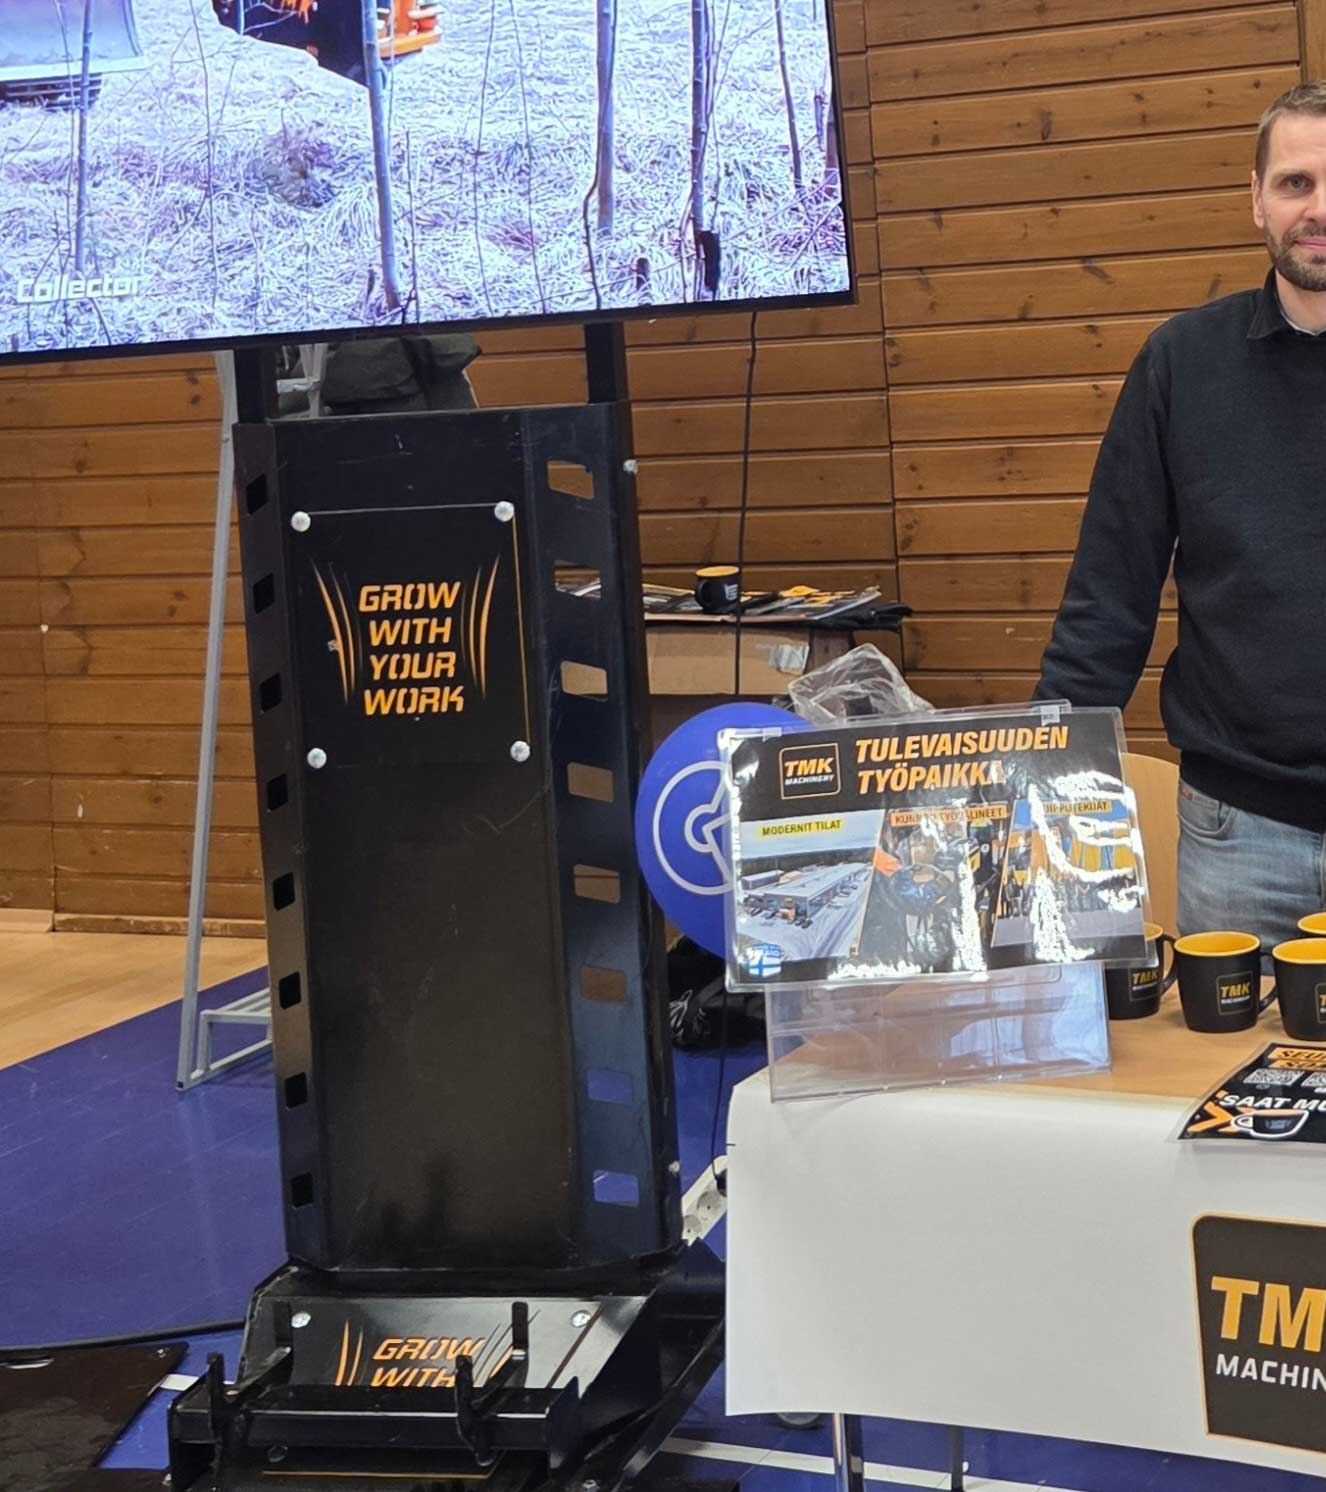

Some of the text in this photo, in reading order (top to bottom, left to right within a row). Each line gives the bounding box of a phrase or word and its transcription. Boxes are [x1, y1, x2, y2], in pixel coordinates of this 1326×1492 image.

[18, 273, 149, 303] Collector
[359, 582, 461, 612] GROW
[369, 617, 452, 646] WITH
[369, 651, 456, 681] YOUR
[363, 685, 464, 716] WORK
[855, 726, 1069, 764] TULEVAISUUDEN
[784, 757, 834, 777] TMK
[785, 774, 834, 786] MACHINERY
[858, 760, 1007, 794] TYÖPAIKKA
[762, 819, 842, 836] MODERNIT TILAT
[1220, 982, 1251, 998] TMK
[1220, 1095, 1291, 1109] SAAT
[373, 1338, 486, 1361] GROW
[370, 1367, 458, 1387] WITH
